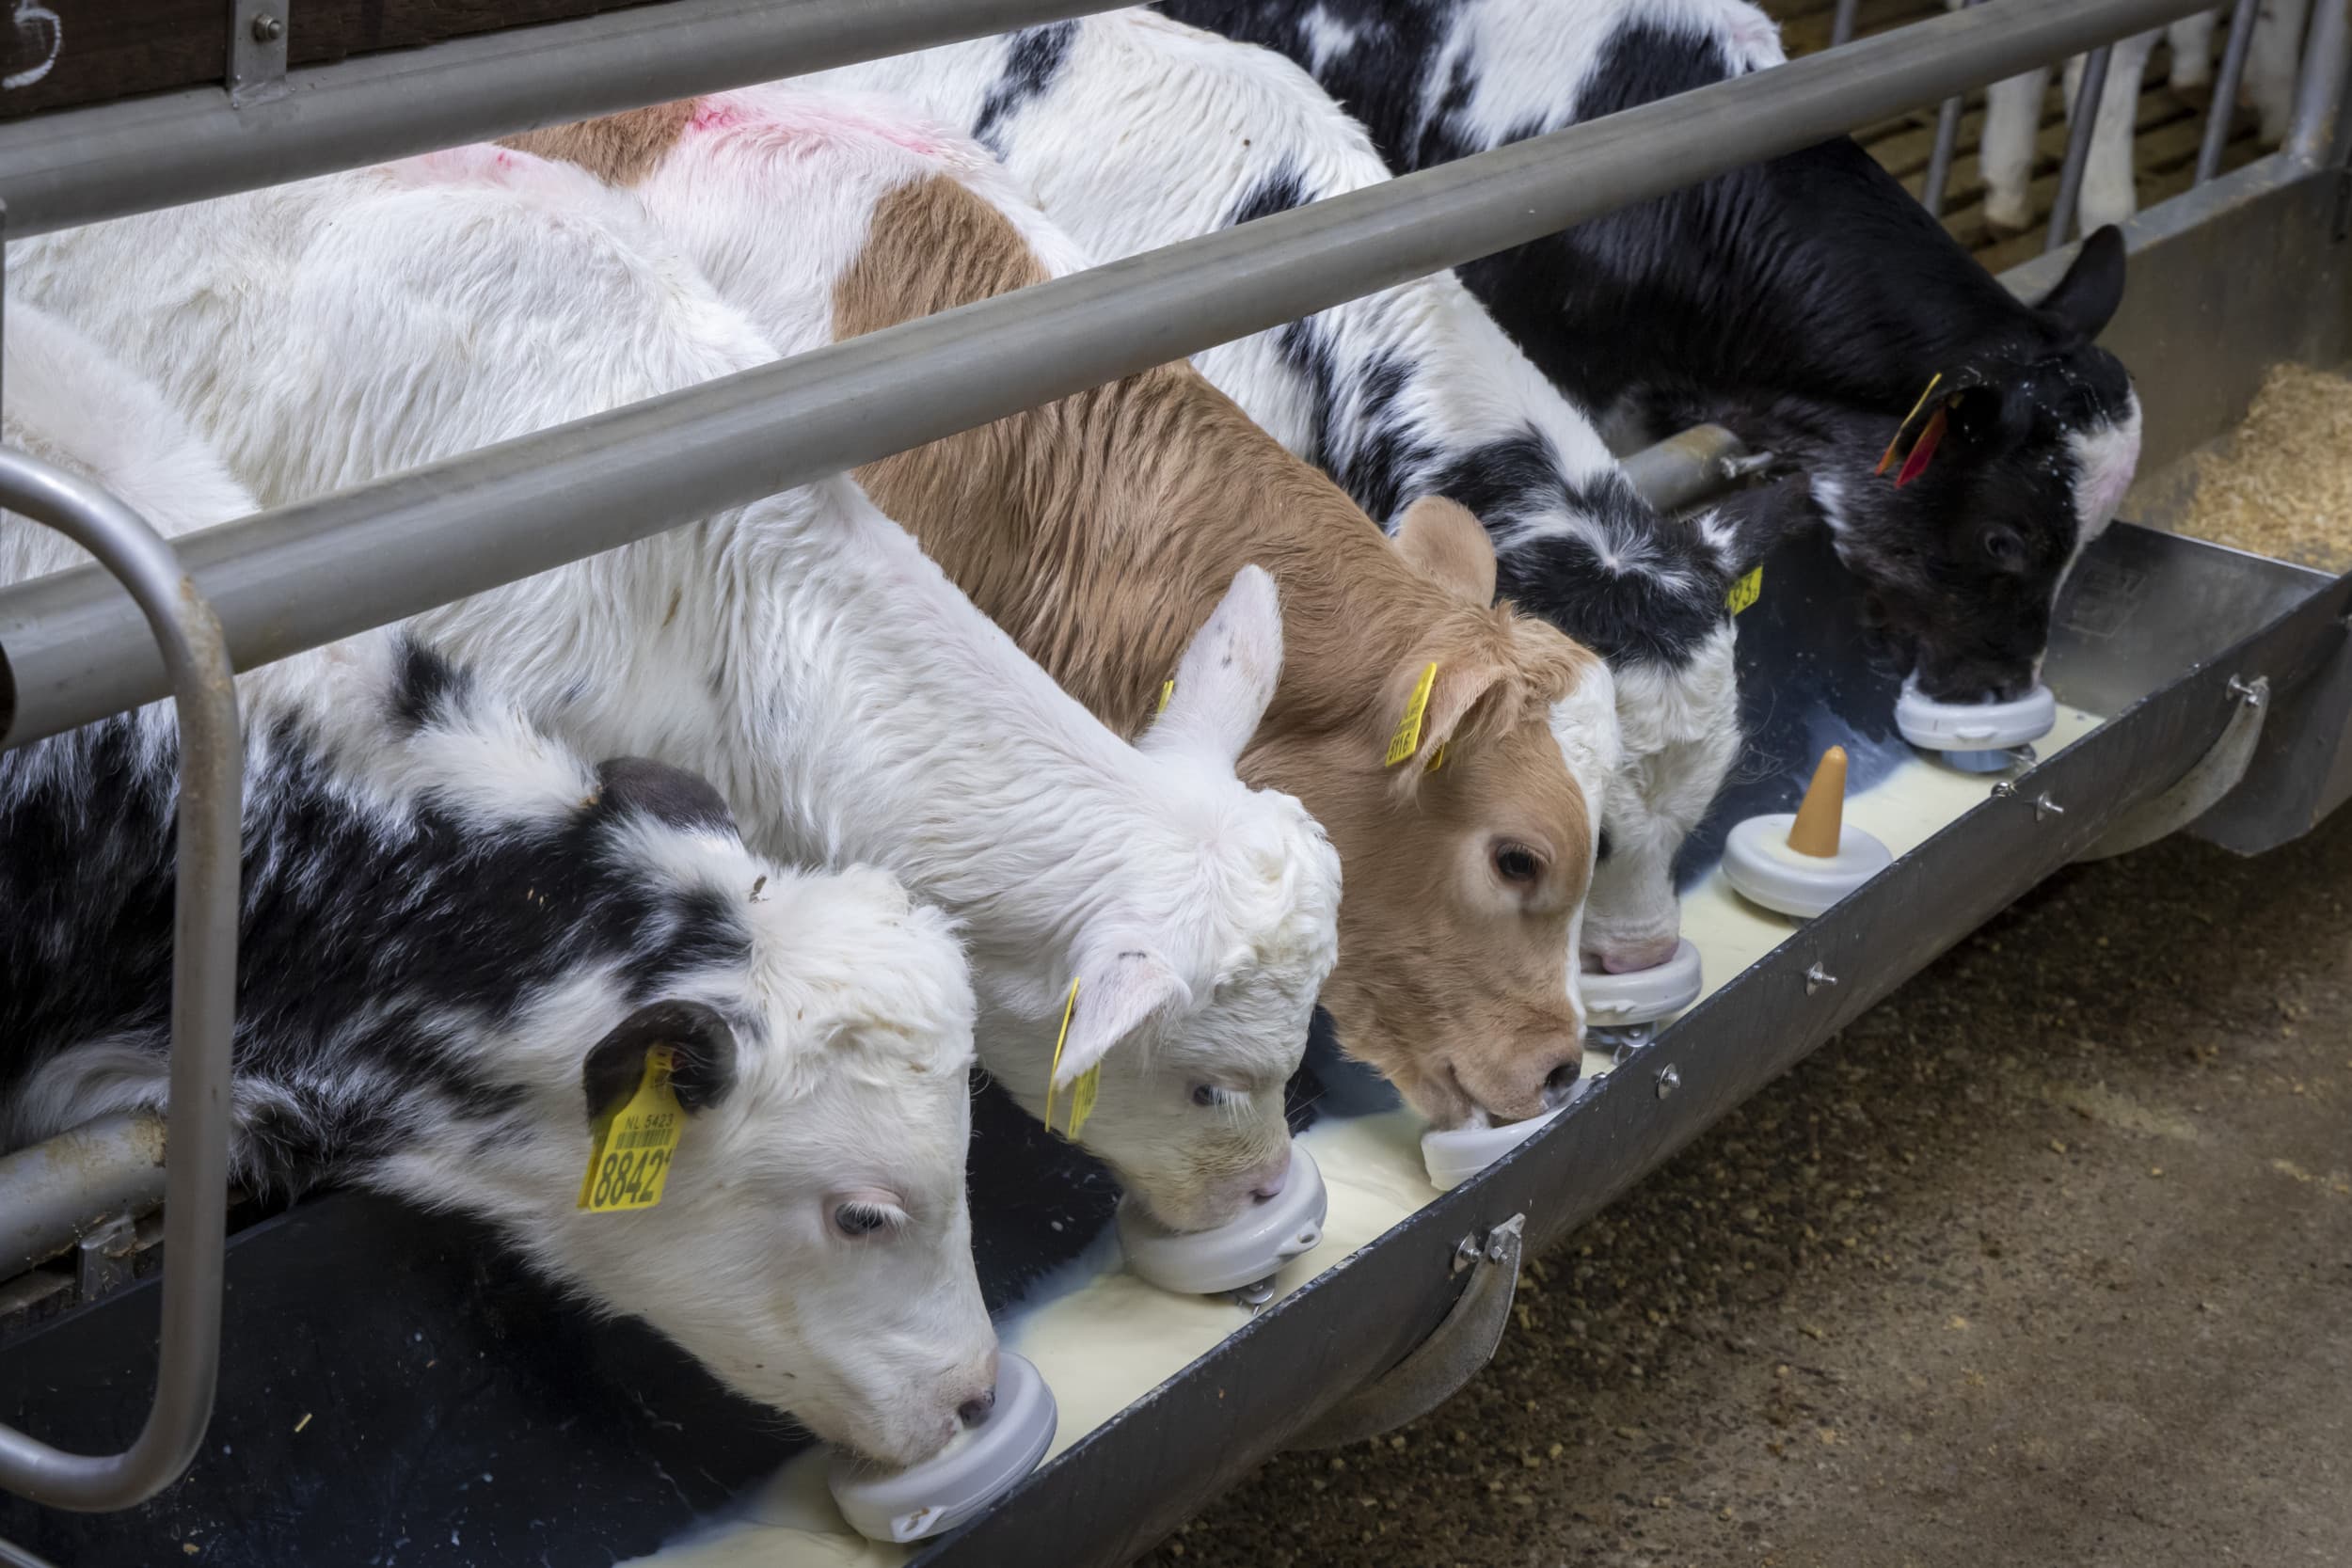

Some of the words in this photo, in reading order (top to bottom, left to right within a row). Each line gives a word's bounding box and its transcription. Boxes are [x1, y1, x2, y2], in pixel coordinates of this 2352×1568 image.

[625, 1117, 640, 1130] NL
[644, 1113, 675, 1130] 5423
[594, 1148, 664, 1208] 8842
